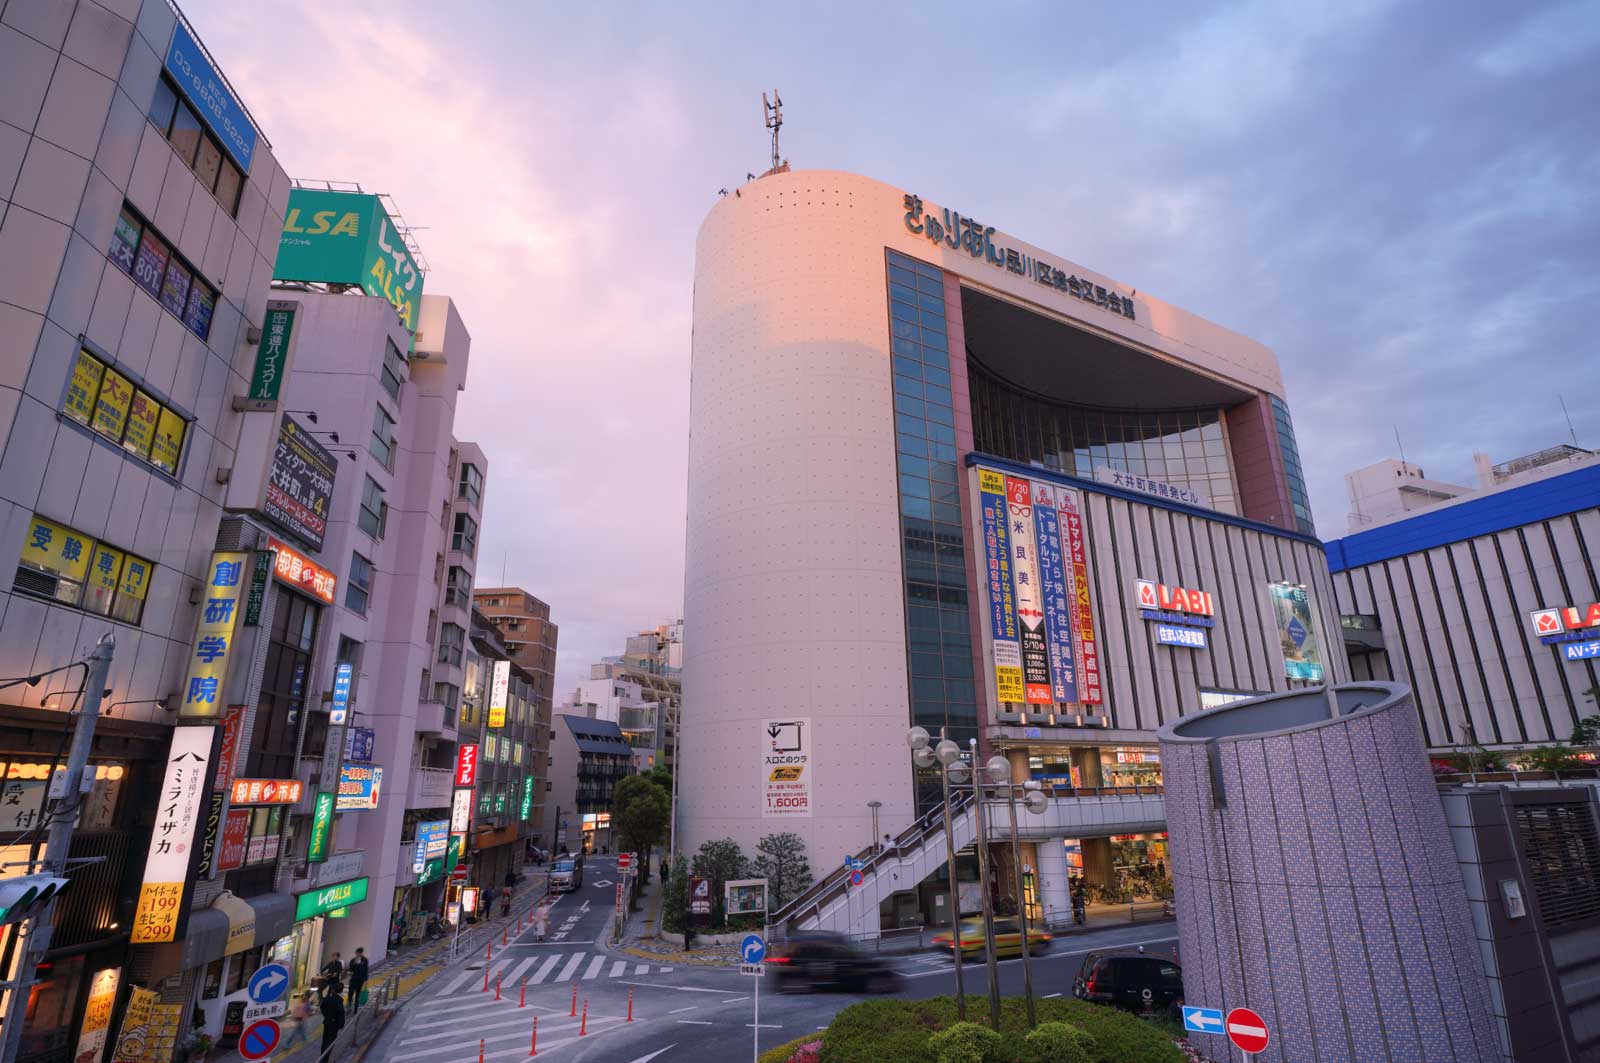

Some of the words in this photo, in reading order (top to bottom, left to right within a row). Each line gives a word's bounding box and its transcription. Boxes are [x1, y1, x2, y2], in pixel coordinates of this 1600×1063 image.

[282, 208, 360, 237] LSA
[378, 218, 417, 291] レイク
[903, 193, 1006, 267] きゅりあん
[1006, 247, 1136, 321] 品川区総合区民会館
[370, 256, 413, 329] ALSA
[257, 324, 286, 399] 東進ハイスクール
[275, 443, 332, 498] ティタワー大井町
[1113, 471, 1199, 504] 大井町再開発ビル
[1007, 481, 1028, 495] 7/30
[30, 524, 145, 586] 受験専門
[1012, 520, 1032, 604] 米良美一
[1157, 583, 1215, 617] LABI
[186, 560, 243, 705] 創研学院
[998, 675, 1021, 685] 品川区
[461, 745, 475, 785] アイフル
[765, 755, 808, 765] 入口このウラ
[4, 783, 37, 829] 受付
[154, 767, 185, 856] ミライザカ
[317, 795, 330, 820] レイク
[767, 797, 808, 809] 1,600円
[145, 885, 180, 898] ハイボール
[317, 888, 335, 907] レイク
[138, 911, 173, 926] 生ビール
[246, 1004, 283, 1019] 自転車を除く
